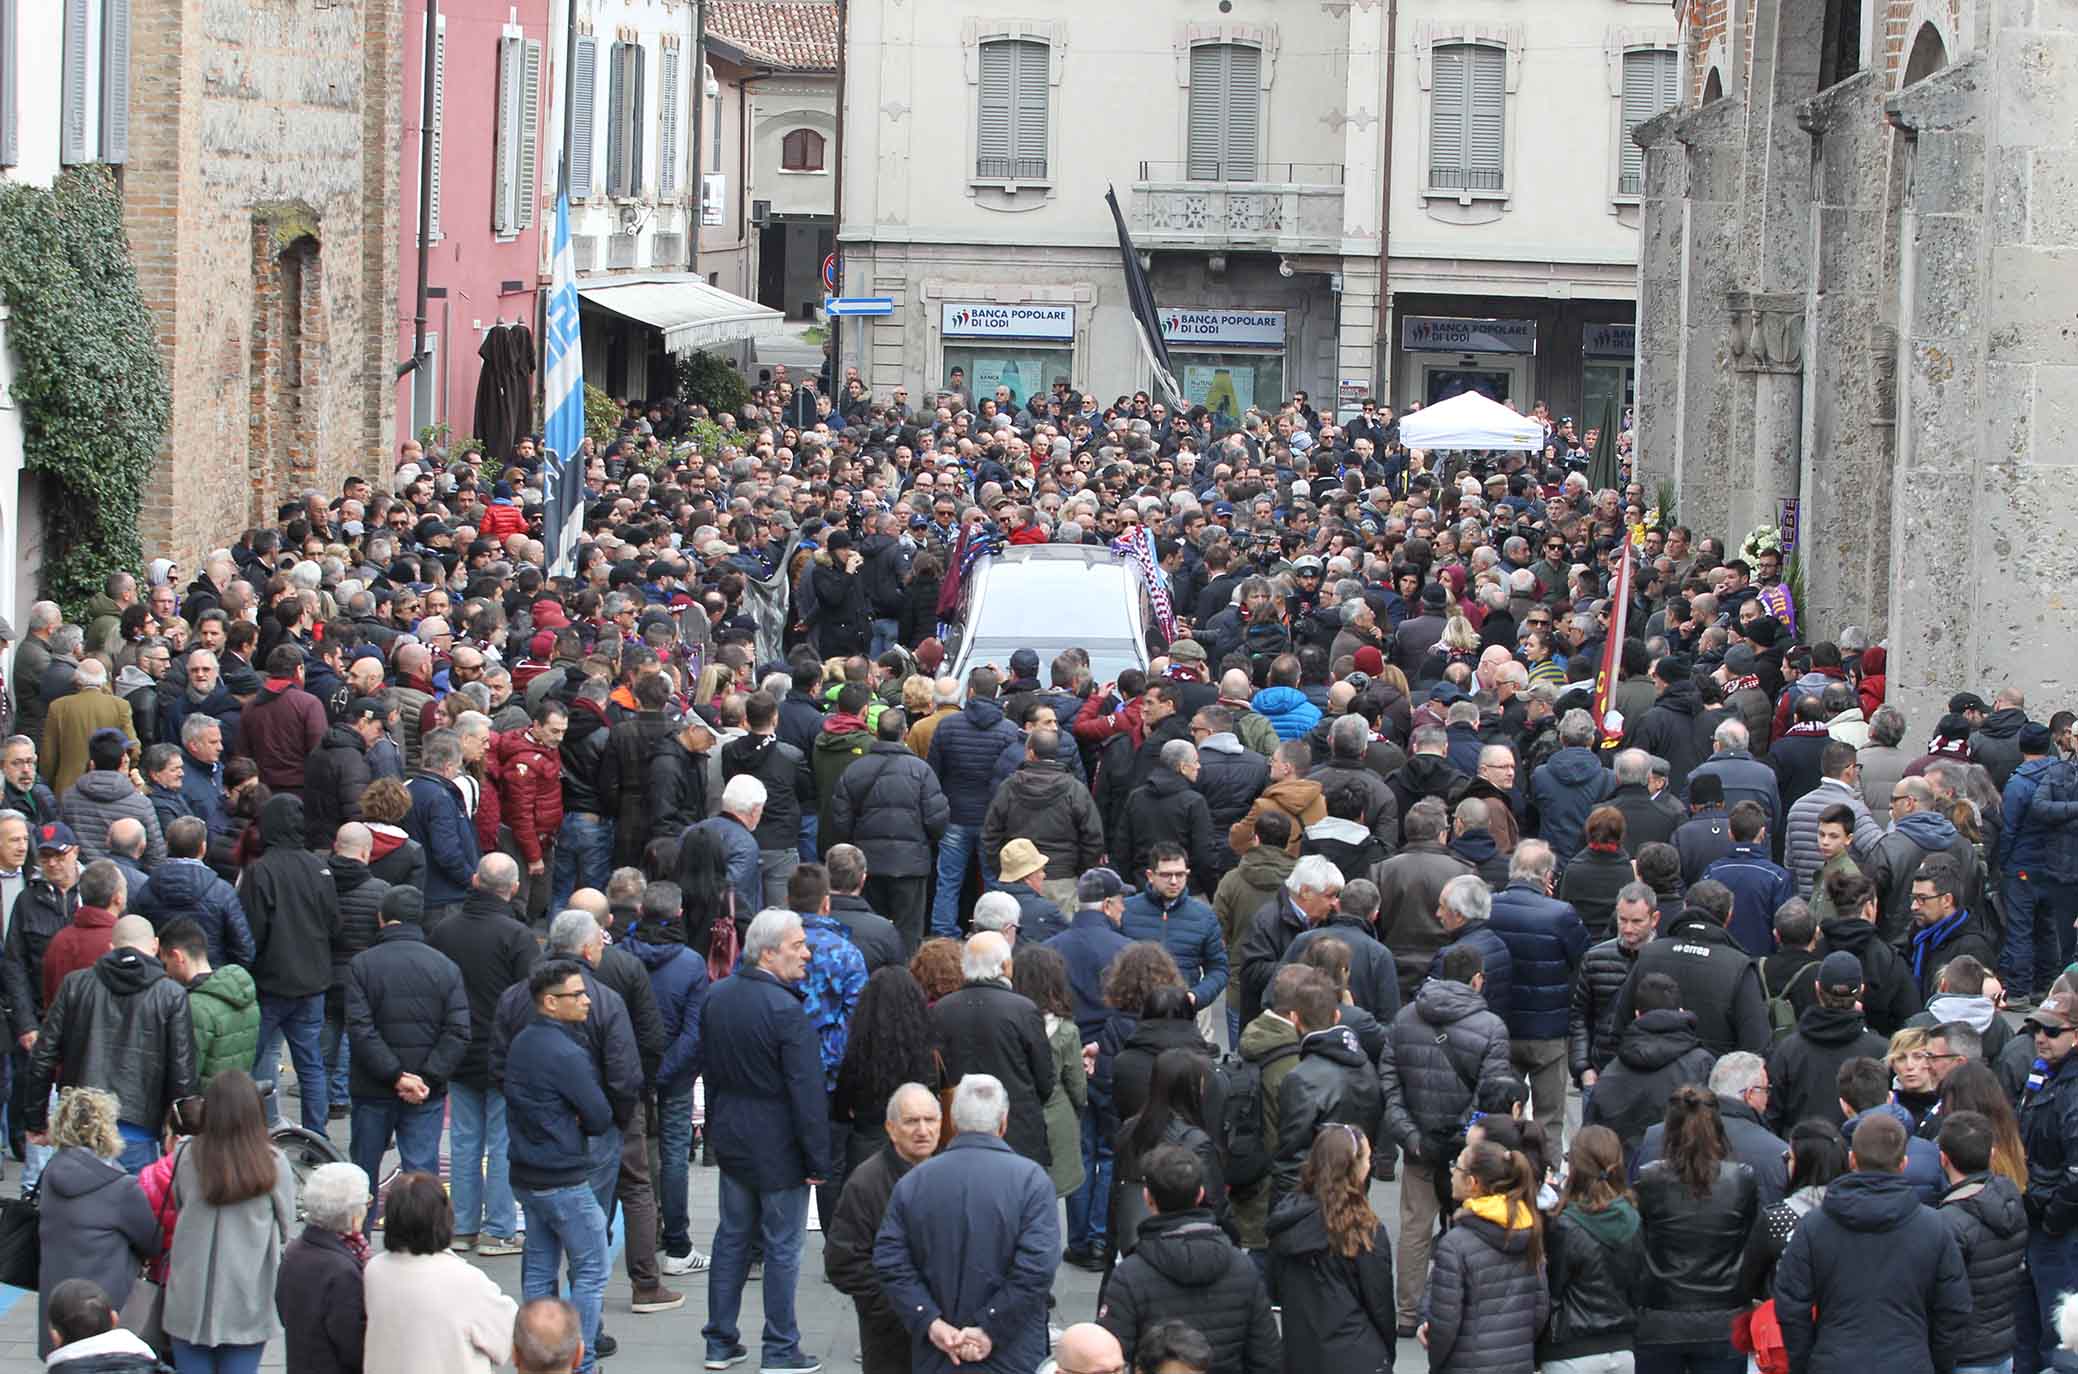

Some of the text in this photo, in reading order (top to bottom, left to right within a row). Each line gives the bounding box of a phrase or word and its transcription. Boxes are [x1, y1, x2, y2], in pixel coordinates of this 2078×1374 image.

[971, 309, 1066, 320] BANCA POPOLARE
[971, 319, 1009, 328] DI LODI
[1181, 315, 1276, 326] BANCA POPOLARE
[1181, 325, 1219, 334] DI LODI
[1431, 322, 1468, 333] BANCA
[1431, 332, 1470, 342] DI LODI
